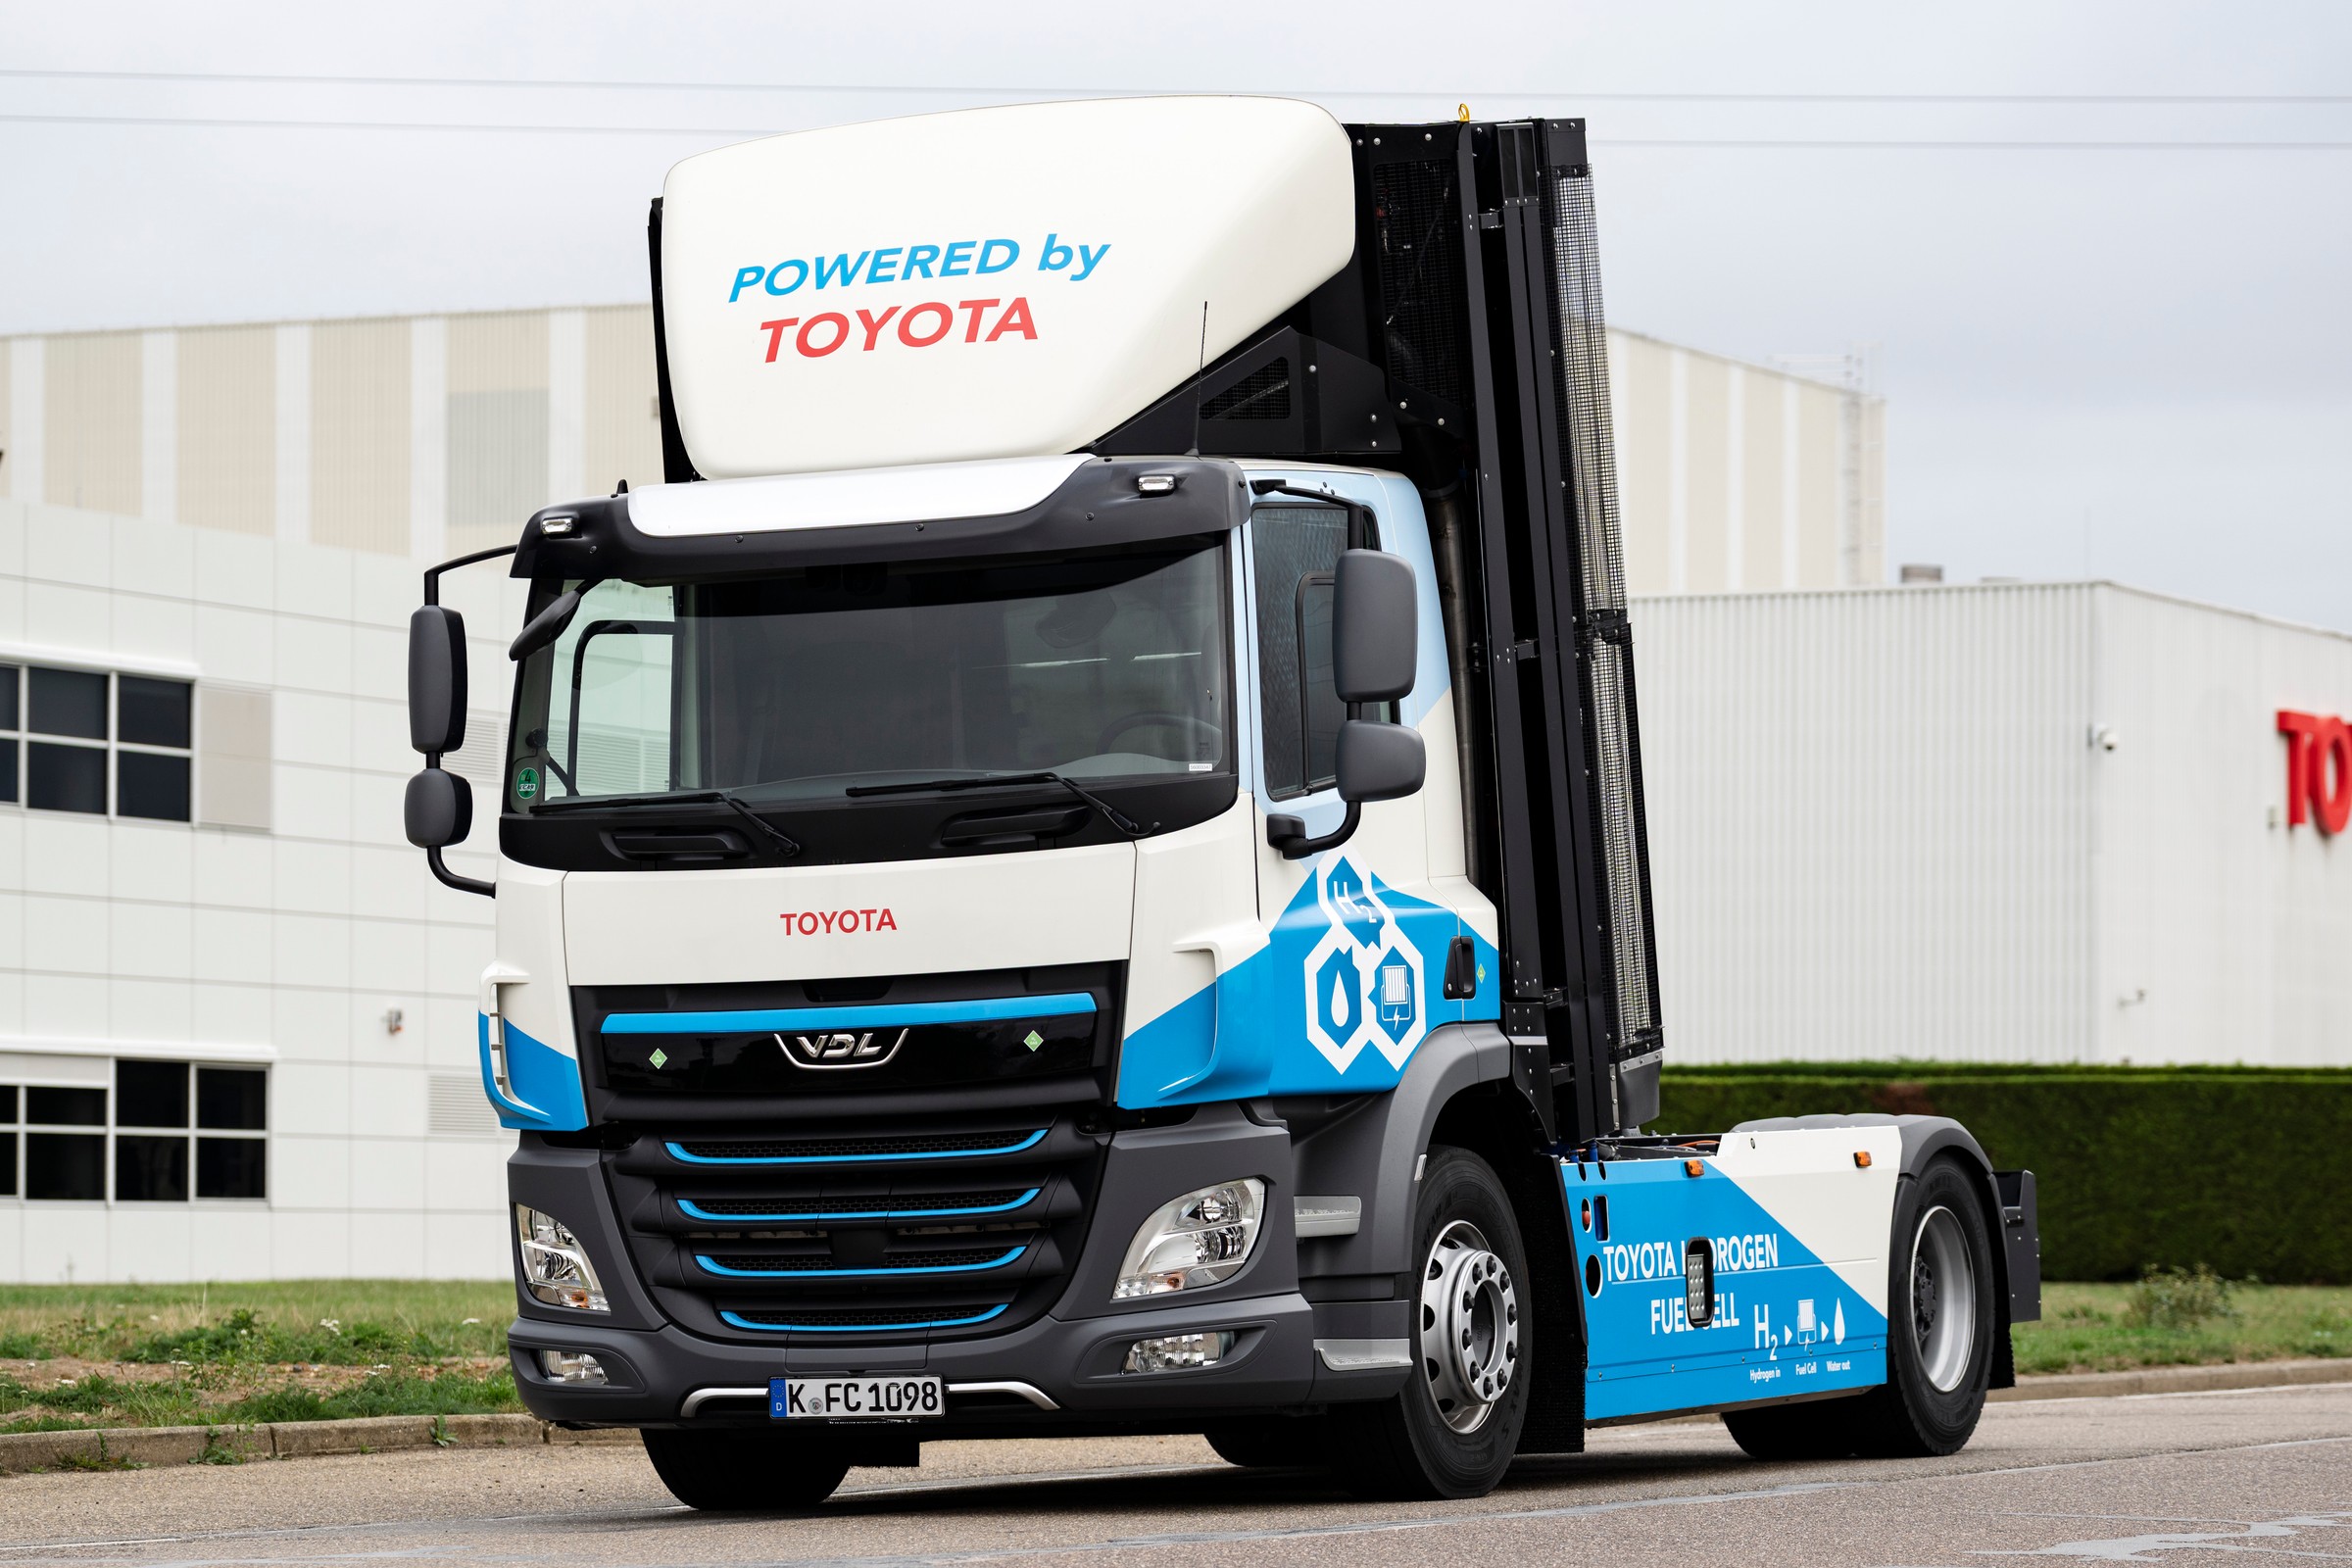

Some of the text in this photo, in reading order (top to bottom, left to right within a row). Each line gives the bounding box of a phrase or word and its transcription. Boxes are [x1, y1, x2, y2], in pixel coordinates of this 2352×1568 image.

[728, 233, 1111, 303] POWERED by
[760, 297, 1038, 363] TOYOTA
[2276, 710, 2352, 834] TO
[780, 907, 898, 936] TOYOTA
[796, 1032, 882, 1058] VDL
[1603, 1233, 1779, 1282] TOYOTA ROGEN
[1702, 1292, 1740, 1331] ELL
[1749, 1366, 1781, 1384] Hydrogen in
[1795, 1361, 1817, 1375] Fuel Cell
[1826, 1360, 1851, 1372] Water out
[775, 1402, 783, 1411] D
[788, 1381, 938, 1413] K FC 1098
